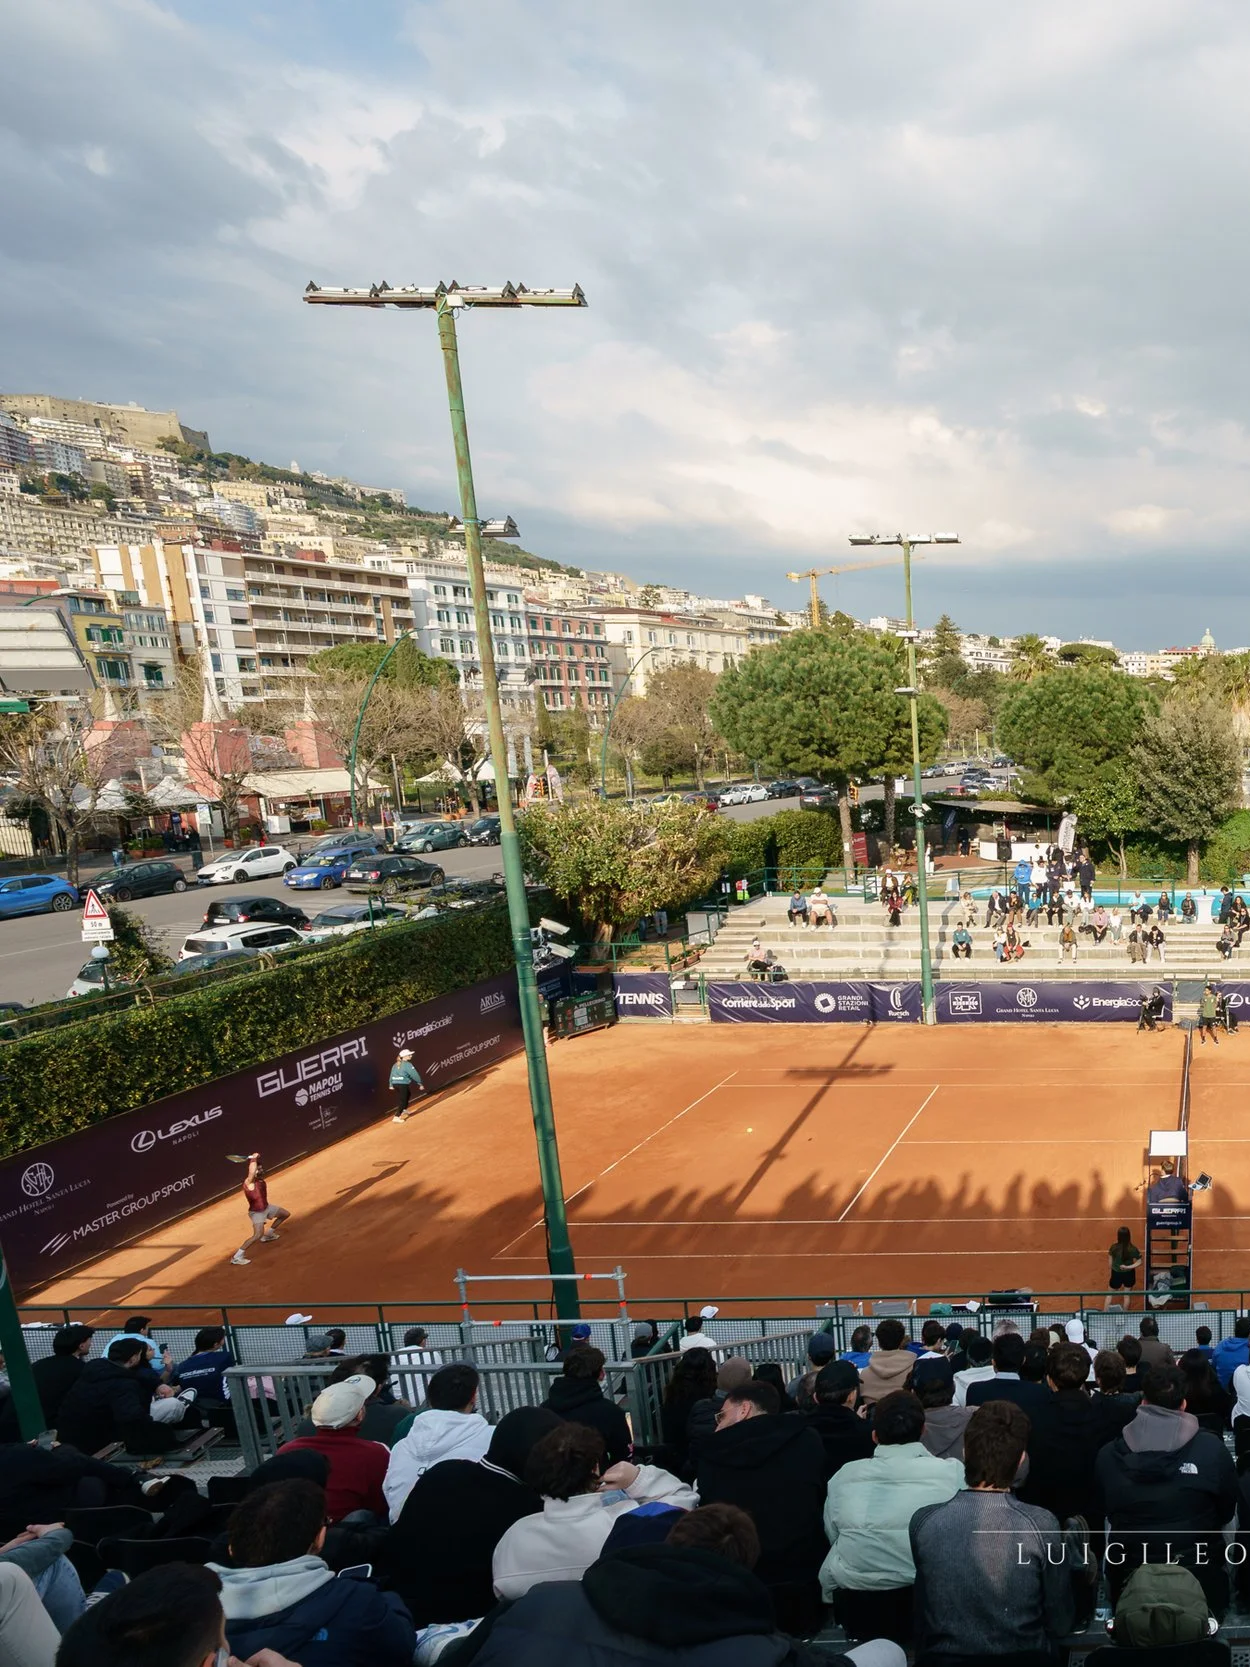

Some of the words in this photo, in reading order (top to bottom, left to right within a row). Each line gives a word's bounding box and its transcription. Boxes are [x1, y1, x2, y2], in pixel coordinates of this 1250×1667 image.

[480, 992, 500, 1009] ARUS
[618, 992, 664, 1005] TENNIS
[1092, 997, 1142, 1009] EnergiaSoc
[257, 1036, 368, 1098] GUERRI
[309, 1072, 342, 1095] NAPOLI
[310, 1087, 331, 1102] TENNIS
[331, 1082, 343, 1093] CUP
[157, 1105, 223, 1139] LEXUS
[172, 1131, 200, 1146] NAPOLI
[73, 1211, 121, 1240] MASTER
[121, 1190, 161, 1217] GROUP
[160, 1173, 196, 1199] SPORT
